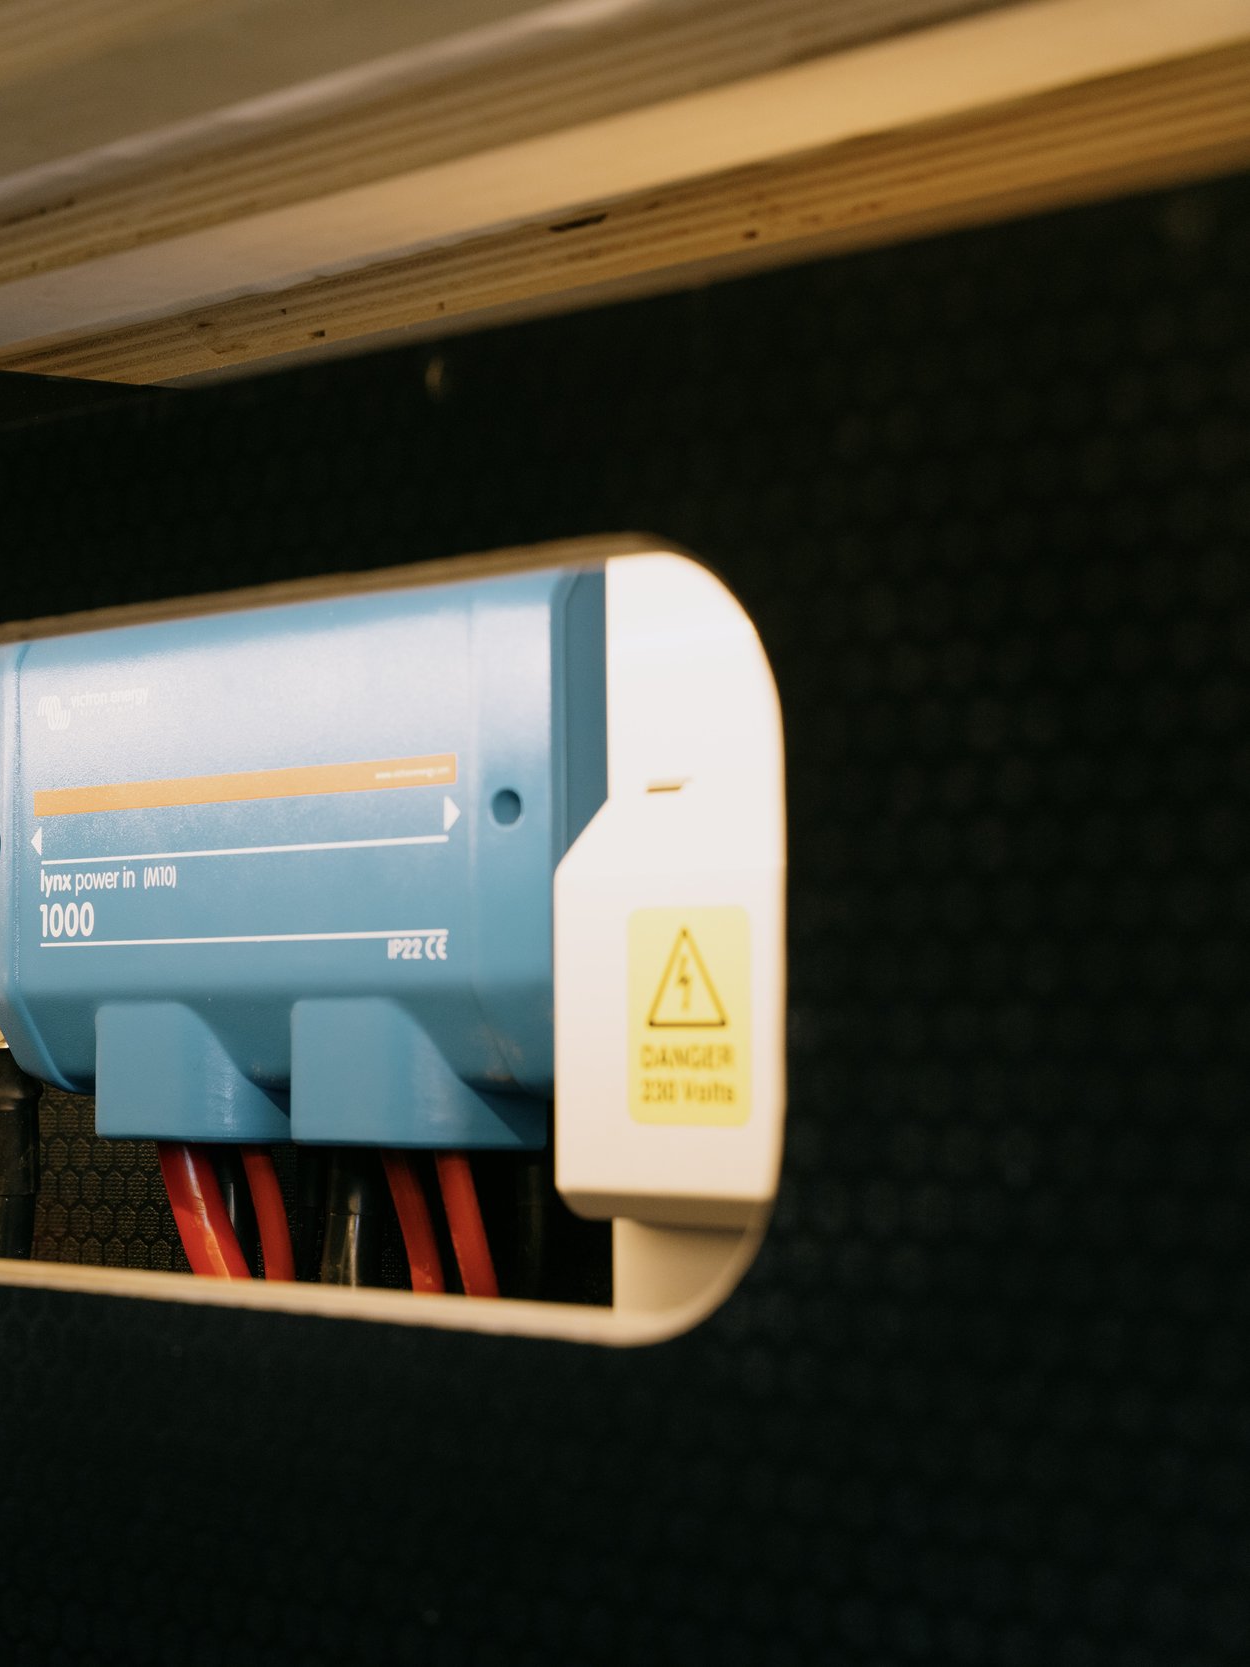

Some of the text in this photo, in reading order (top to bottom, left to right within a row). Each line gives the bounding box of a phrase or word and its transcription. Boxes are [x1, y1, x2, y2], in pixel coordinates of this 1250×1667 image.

[70, 687, 150, 708] victron energy
[40, 864, 177, 898] lynx power in (M10)
[39, 901, 95, 938] 1000
[387, 938, 423, 960] IP22
[640, 1043, 735, 1070] DANGER
[641, 1078, 736, 1104] 230 Volts
